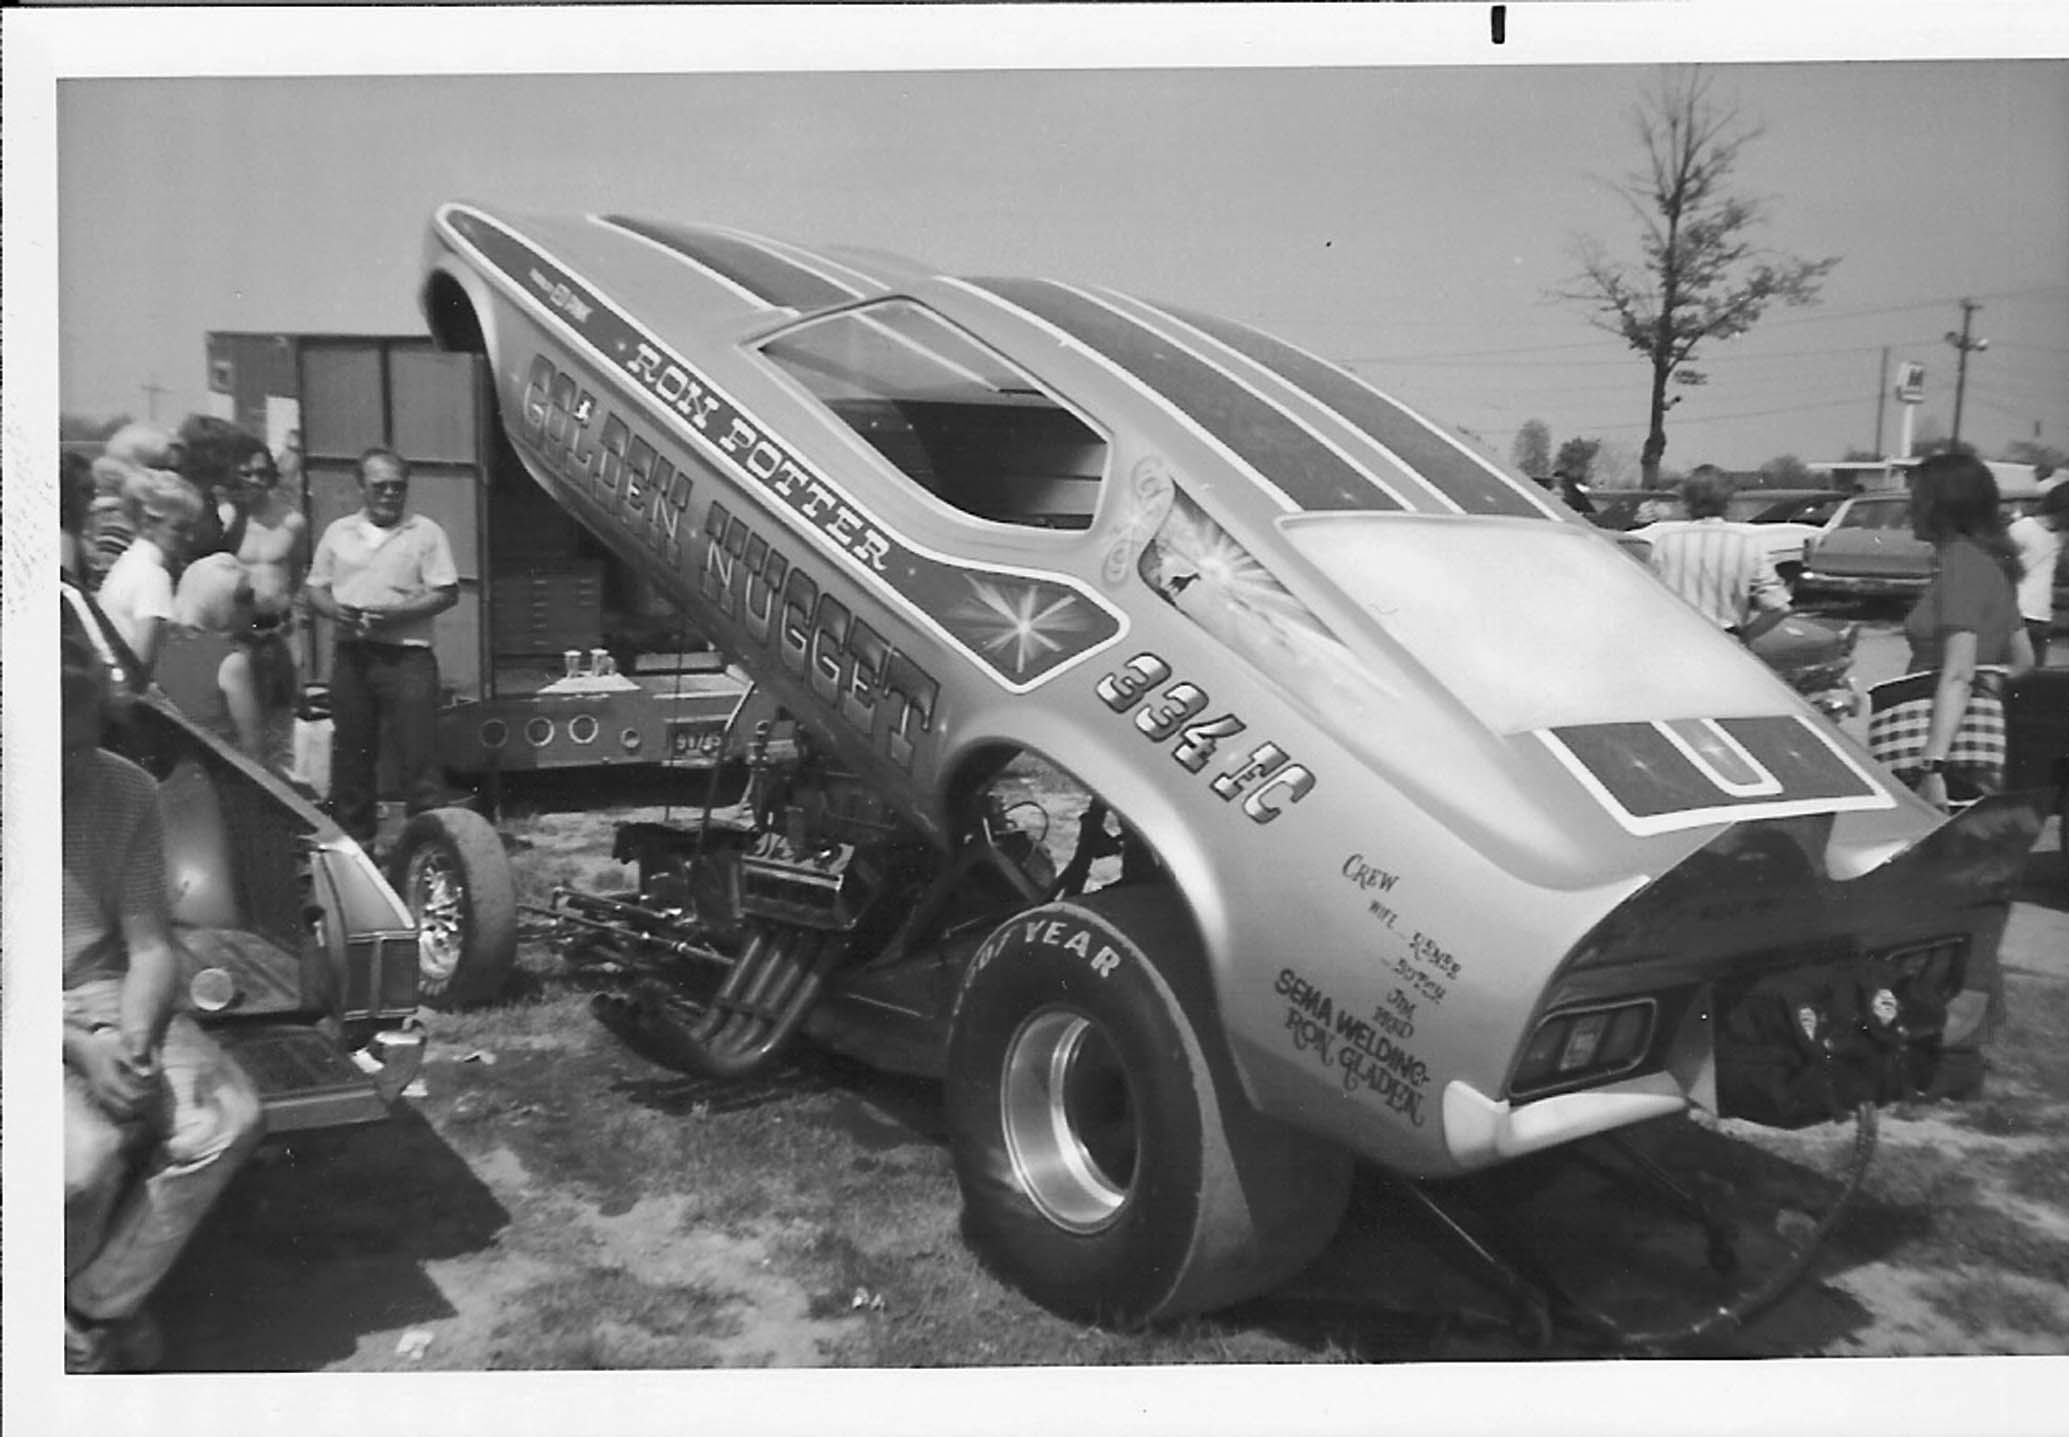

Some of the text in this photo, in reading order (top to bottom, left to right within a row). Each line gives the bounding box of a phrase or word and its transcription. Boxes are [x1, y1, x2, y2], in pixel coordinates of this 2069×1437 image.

[626, 343, 893, 572] RON POTTER
[522, 353, 940, 766] GOLDEN NUGGET
[1095, 652, 1317, 825] 334 FC
[1341, 853, 1400, 892] CREW
[1274, 968, 1333, 1027] SEMA
[1284, 1007, 1336, 1067] RON
